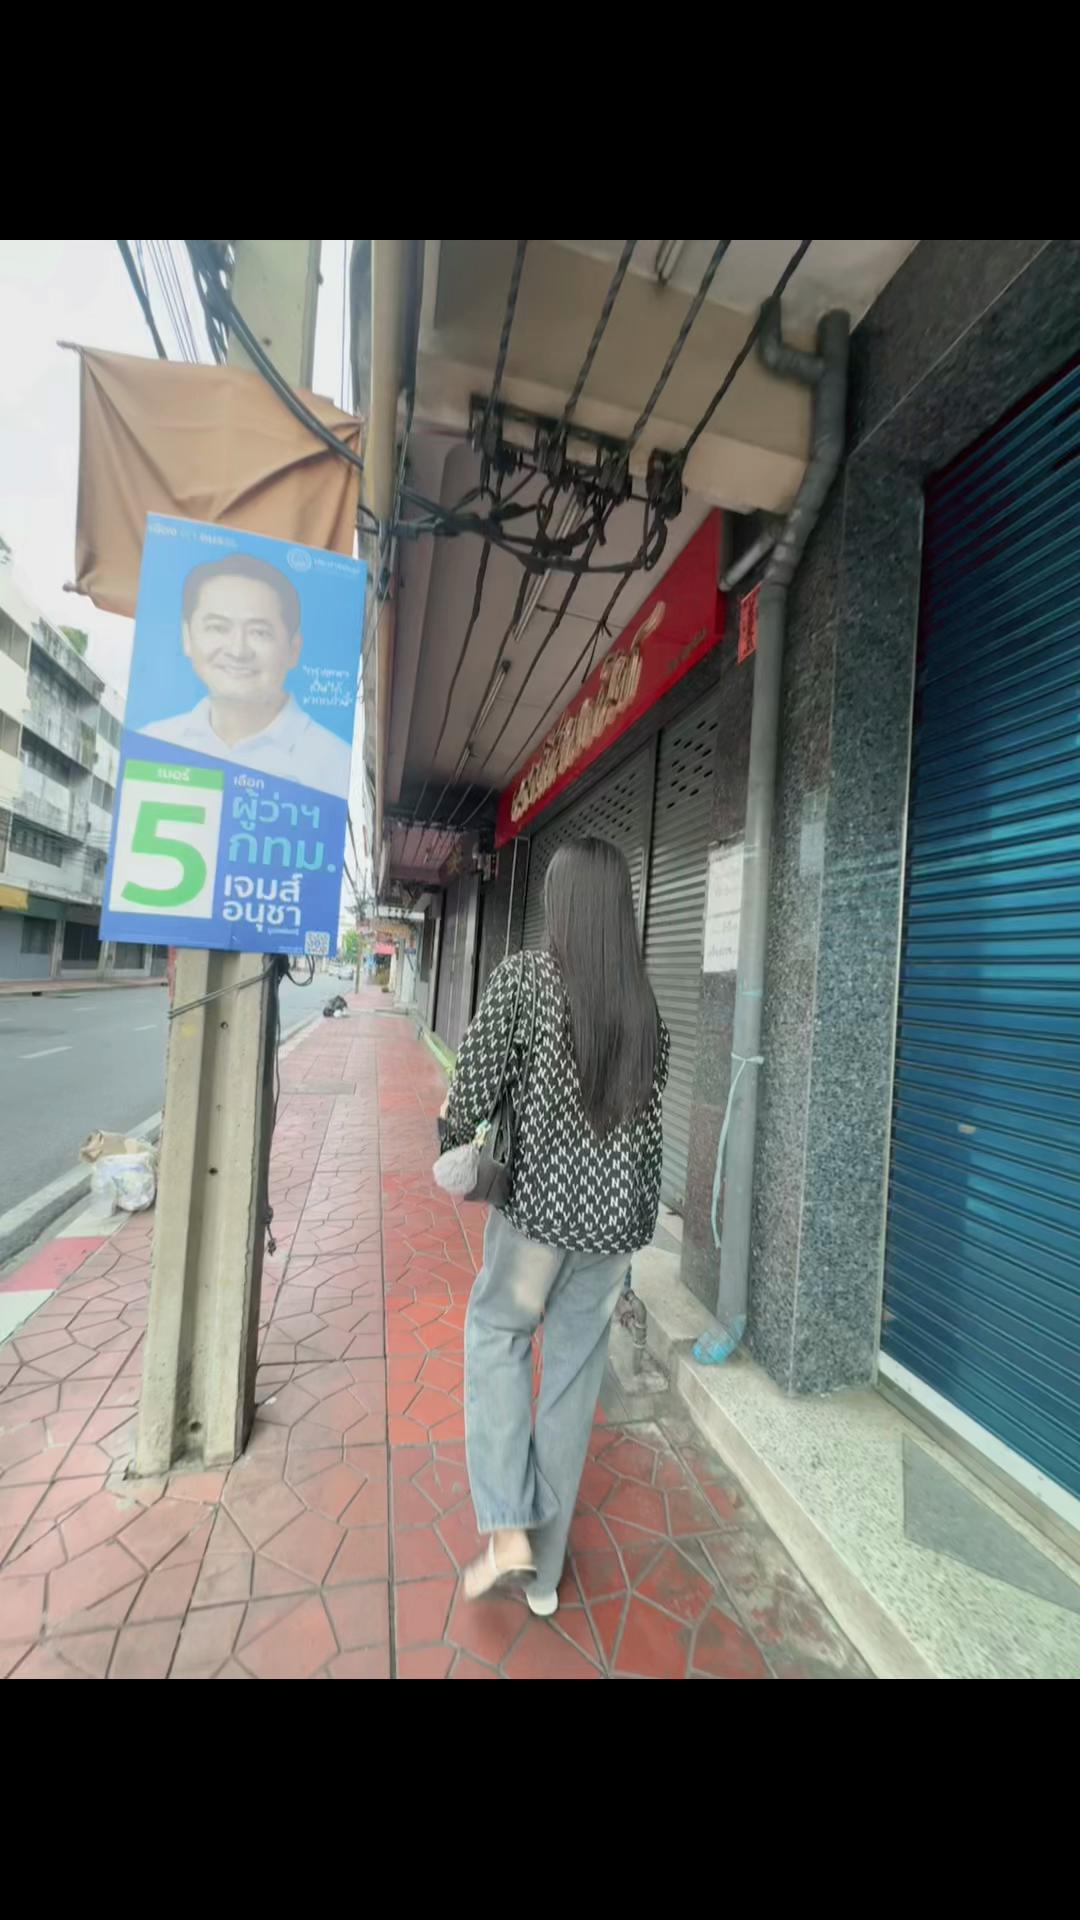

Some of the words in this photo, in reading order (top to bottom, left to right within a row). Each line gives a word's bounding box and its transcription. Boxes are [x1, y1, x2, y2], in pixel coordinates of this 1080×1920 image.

[157, 767, 191, 783] เบอร์
[233, 773, 264, 790] เลือก
[232, 788, 320, 831] ผู้ว่าฯ
[121, 800, 208, 907] 5
[228, 832, 336, 873] กทม.
[224, 872, 303, 904] เจมส์
[222, 900, 302, 932] อนุชา
